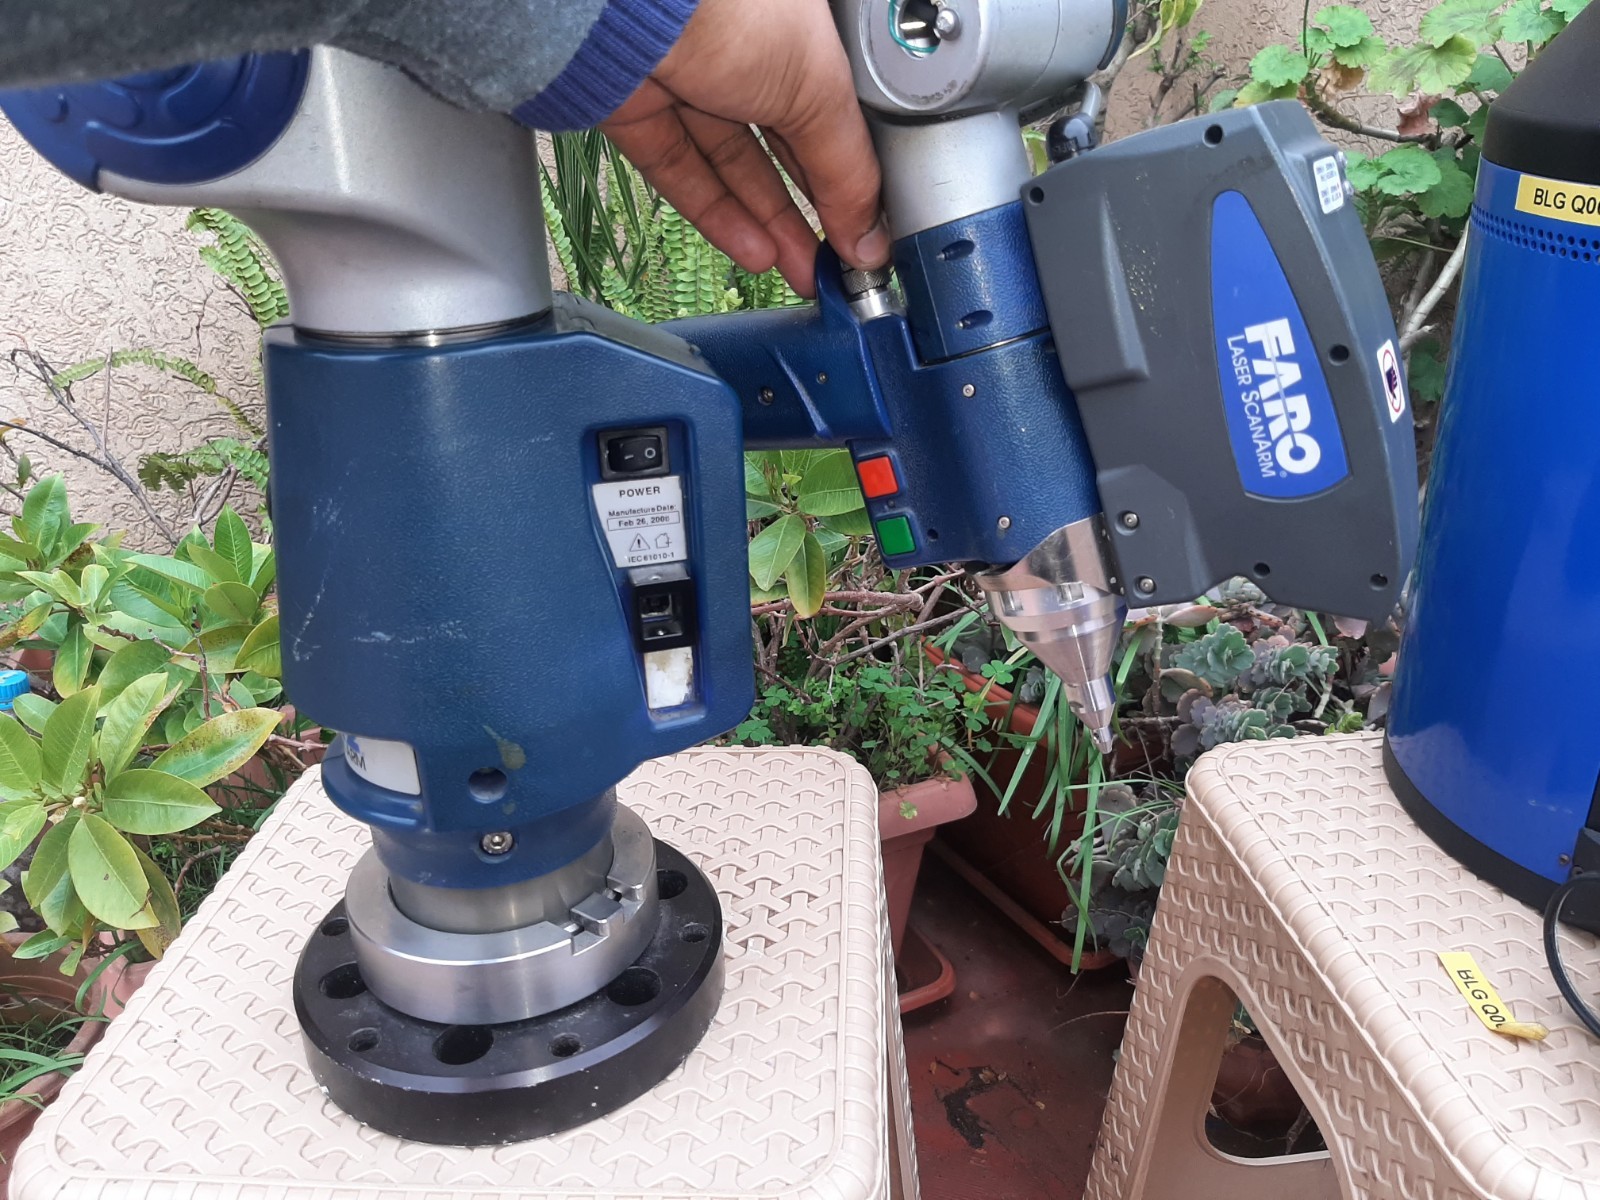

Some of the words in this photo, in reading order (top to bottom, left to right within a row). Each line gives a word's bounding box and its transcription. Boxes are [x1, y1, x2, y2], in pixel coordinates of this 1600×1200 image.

[1533, 187, 1566, 210] BLG
[1244, 318, 1321, 474] FARO
[1227, 334, 1252, 386] LASER
[1241, 389, 1276, 478] SCANARM
[619, 486, 661, 498] POWER
[608, 506, 656, 517] Manufacture
[618, 519, 634, 528] Feb
